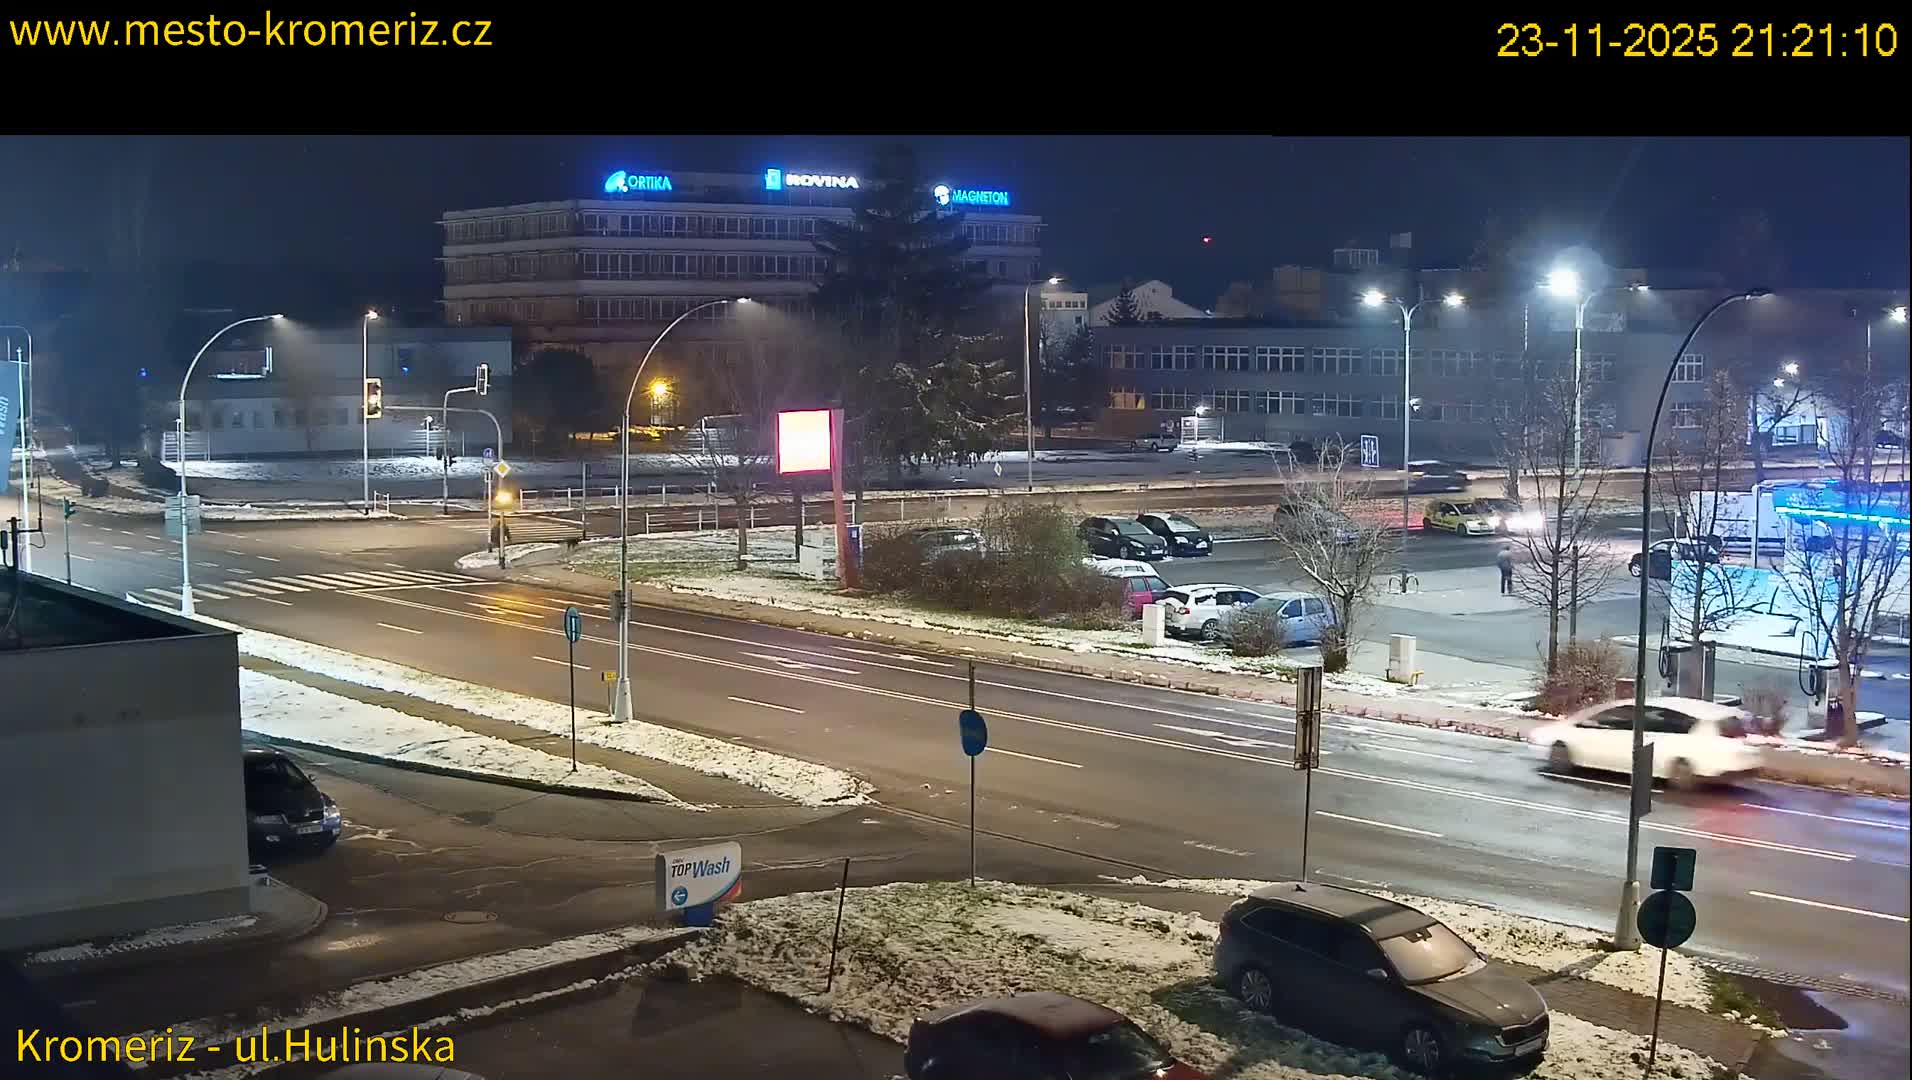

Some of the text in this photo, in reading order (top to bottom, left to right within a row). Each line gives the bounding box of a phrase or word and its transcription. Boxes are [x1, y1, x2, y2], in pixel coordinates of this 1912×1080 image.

[628, 175, 672, 191] ORTIKA
[786, 173, 860, 189] ROVINA
[952, 189, 1009, 206] MAGNETON
